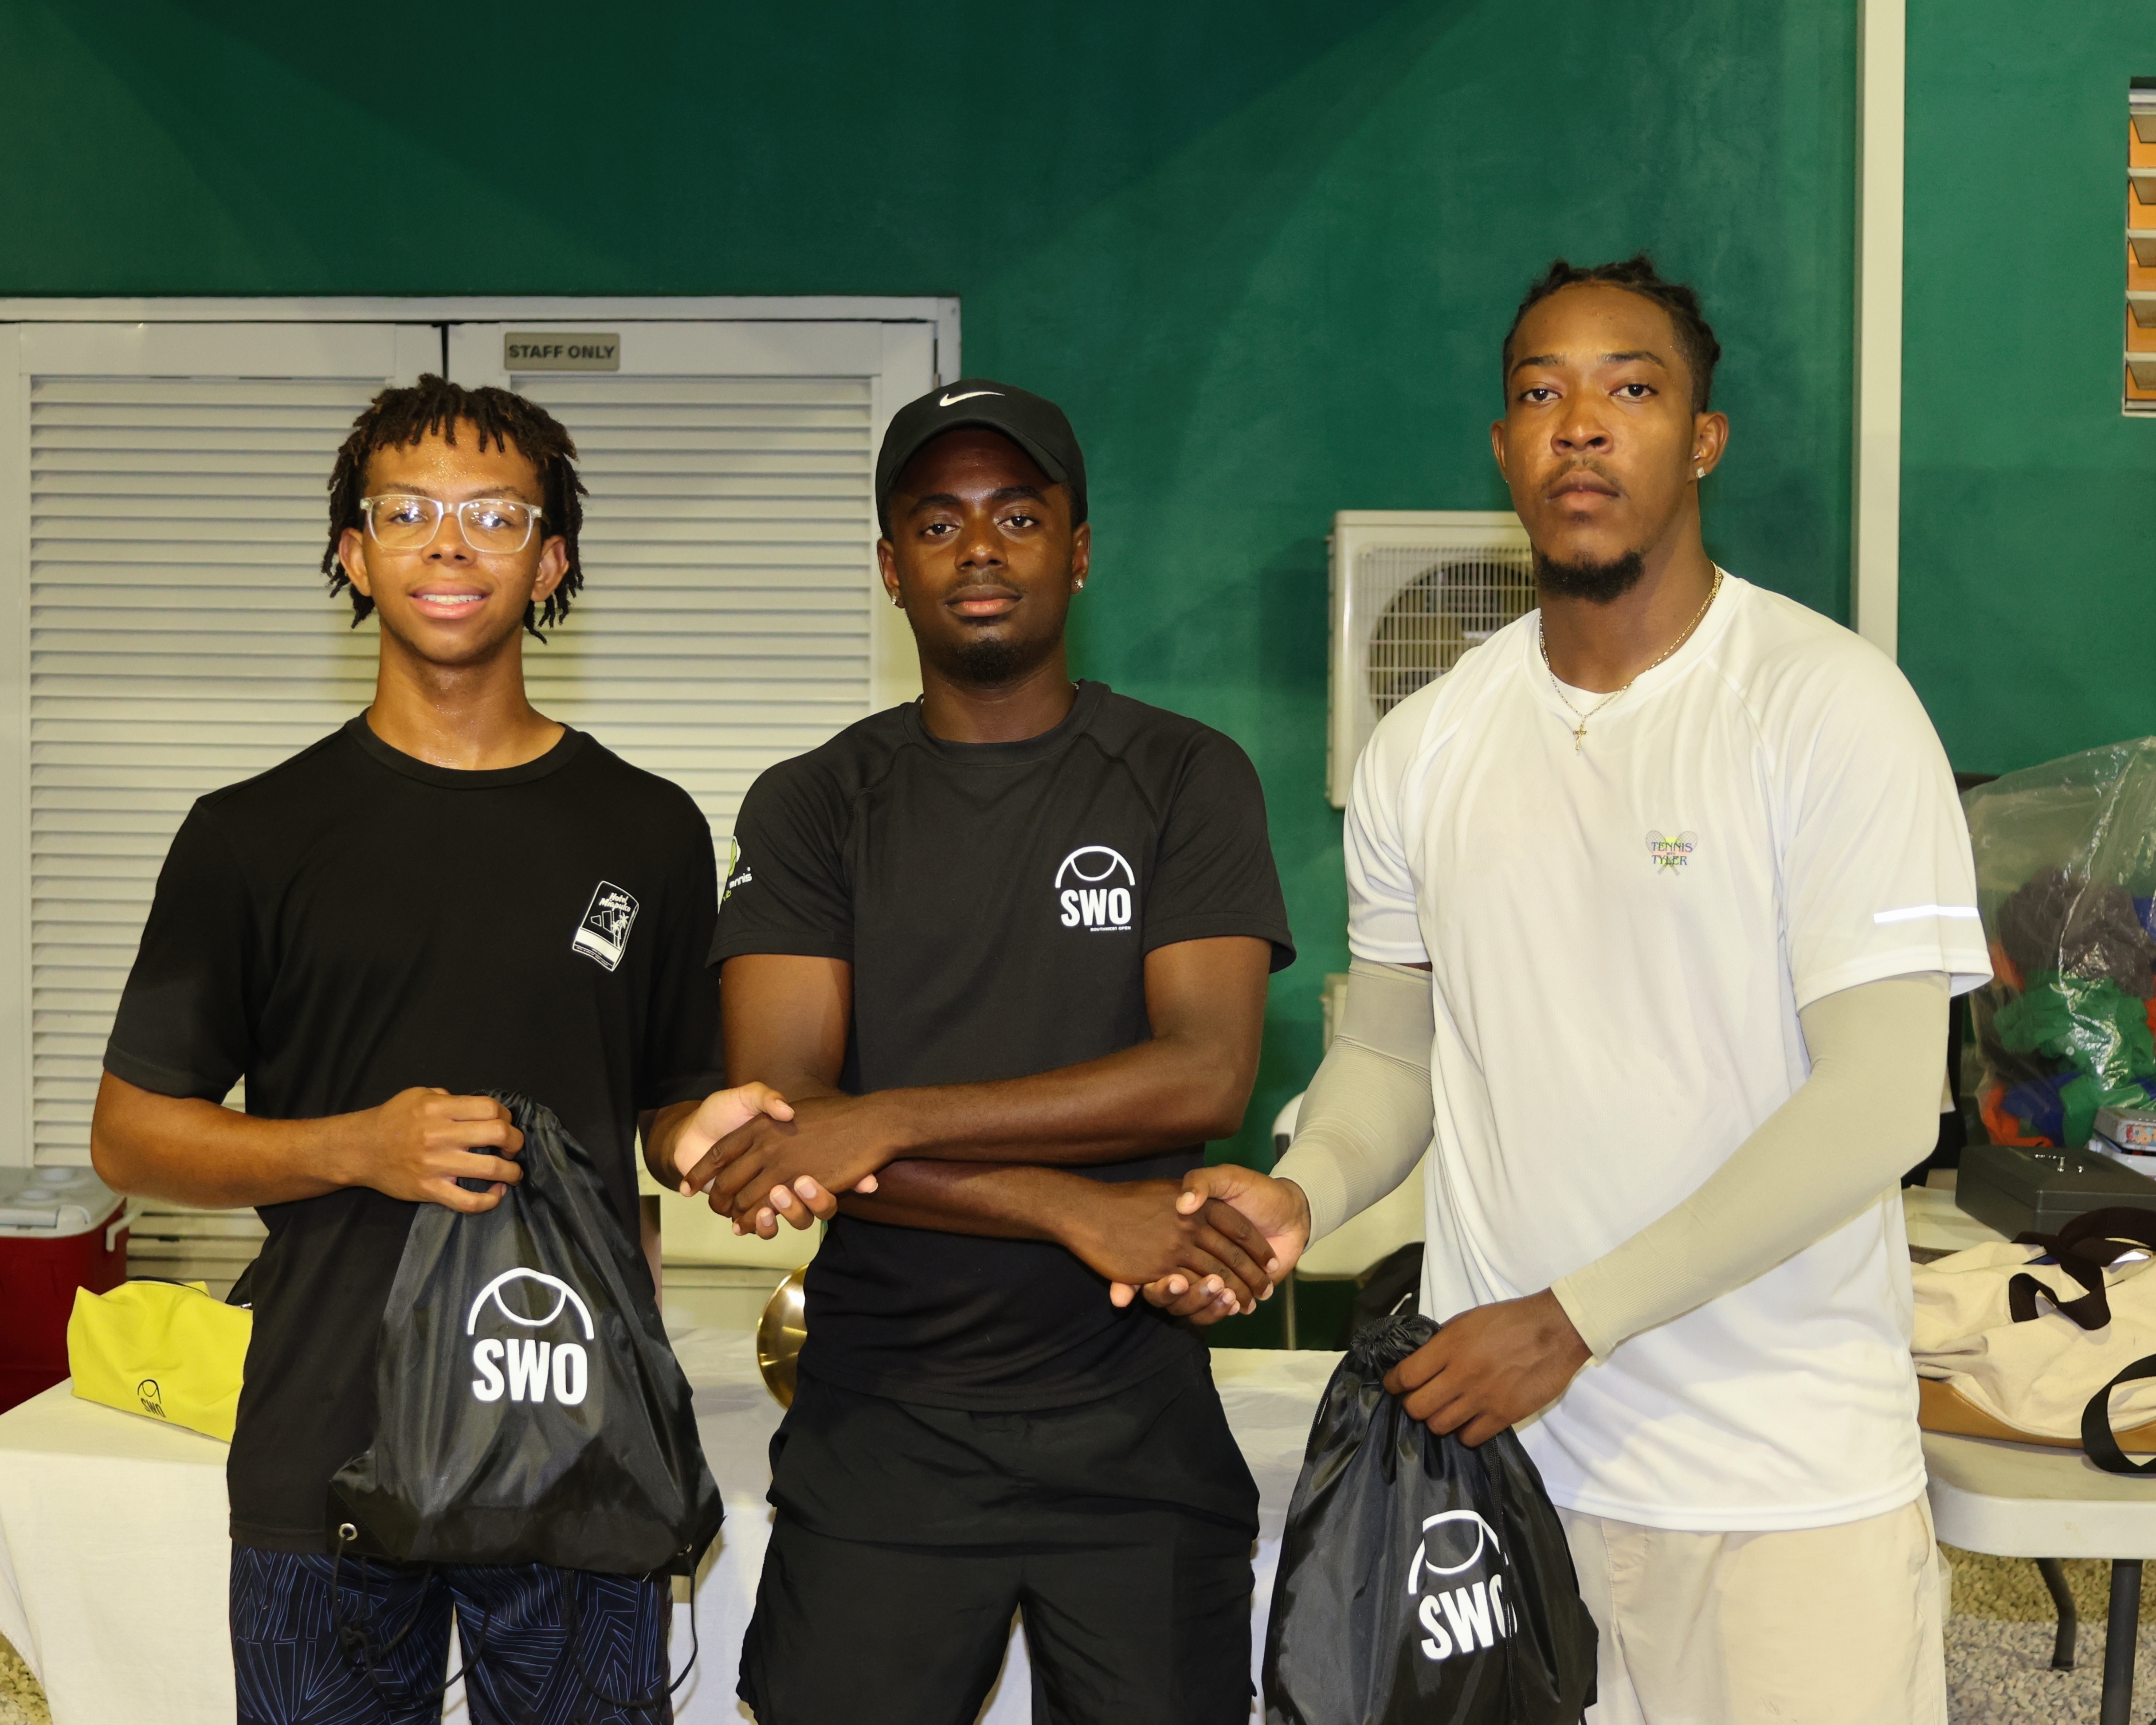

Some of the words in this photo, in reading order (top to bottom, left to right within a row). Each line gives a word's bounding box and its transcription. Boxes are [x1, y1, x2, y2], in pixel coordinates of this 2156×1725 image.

[509, 345, 564, 358] STAFF
[567, 345, 615, 358] ONLY
[1651, 842, 1693, 852] TENNIS
[1651, 855, 1687, 865] TYLER
[729, 873, 752, 889] ennis
[609, 893, 628, 903] Hotel
[1060, 888, 1131, 927] SWO
[472, 1338, 588, 1405] SWO
[141, 1398, 166, 1418] SWO
